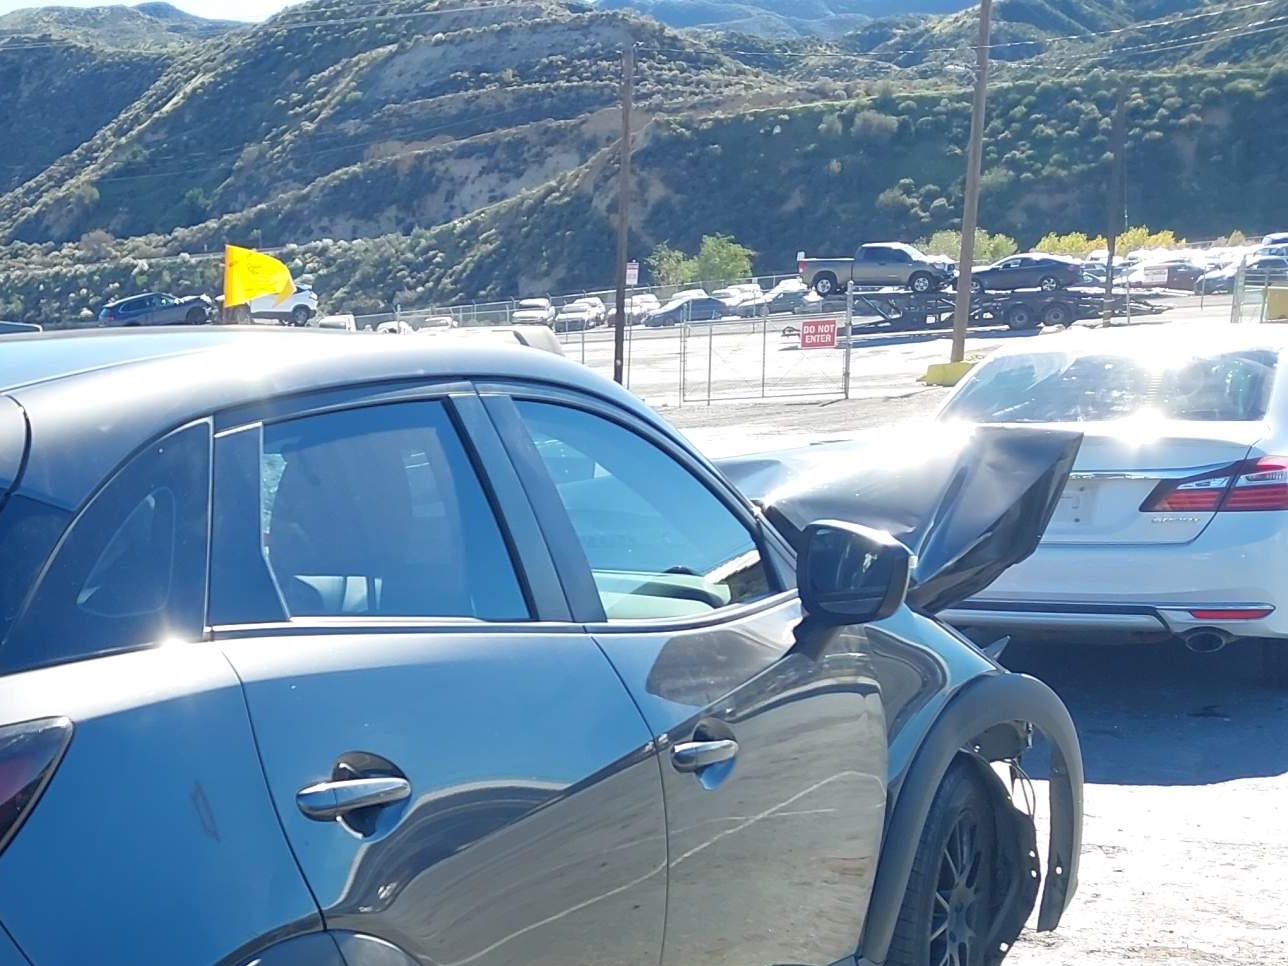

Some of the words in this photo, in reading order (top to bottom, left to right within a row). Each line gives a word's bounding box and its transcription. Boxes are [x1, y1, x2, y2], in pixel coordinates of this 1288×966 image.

[804, 326, 816, 334] DO
[818, 325, 835, 333] NOT
[806, 334, 832, 343] ENTER
